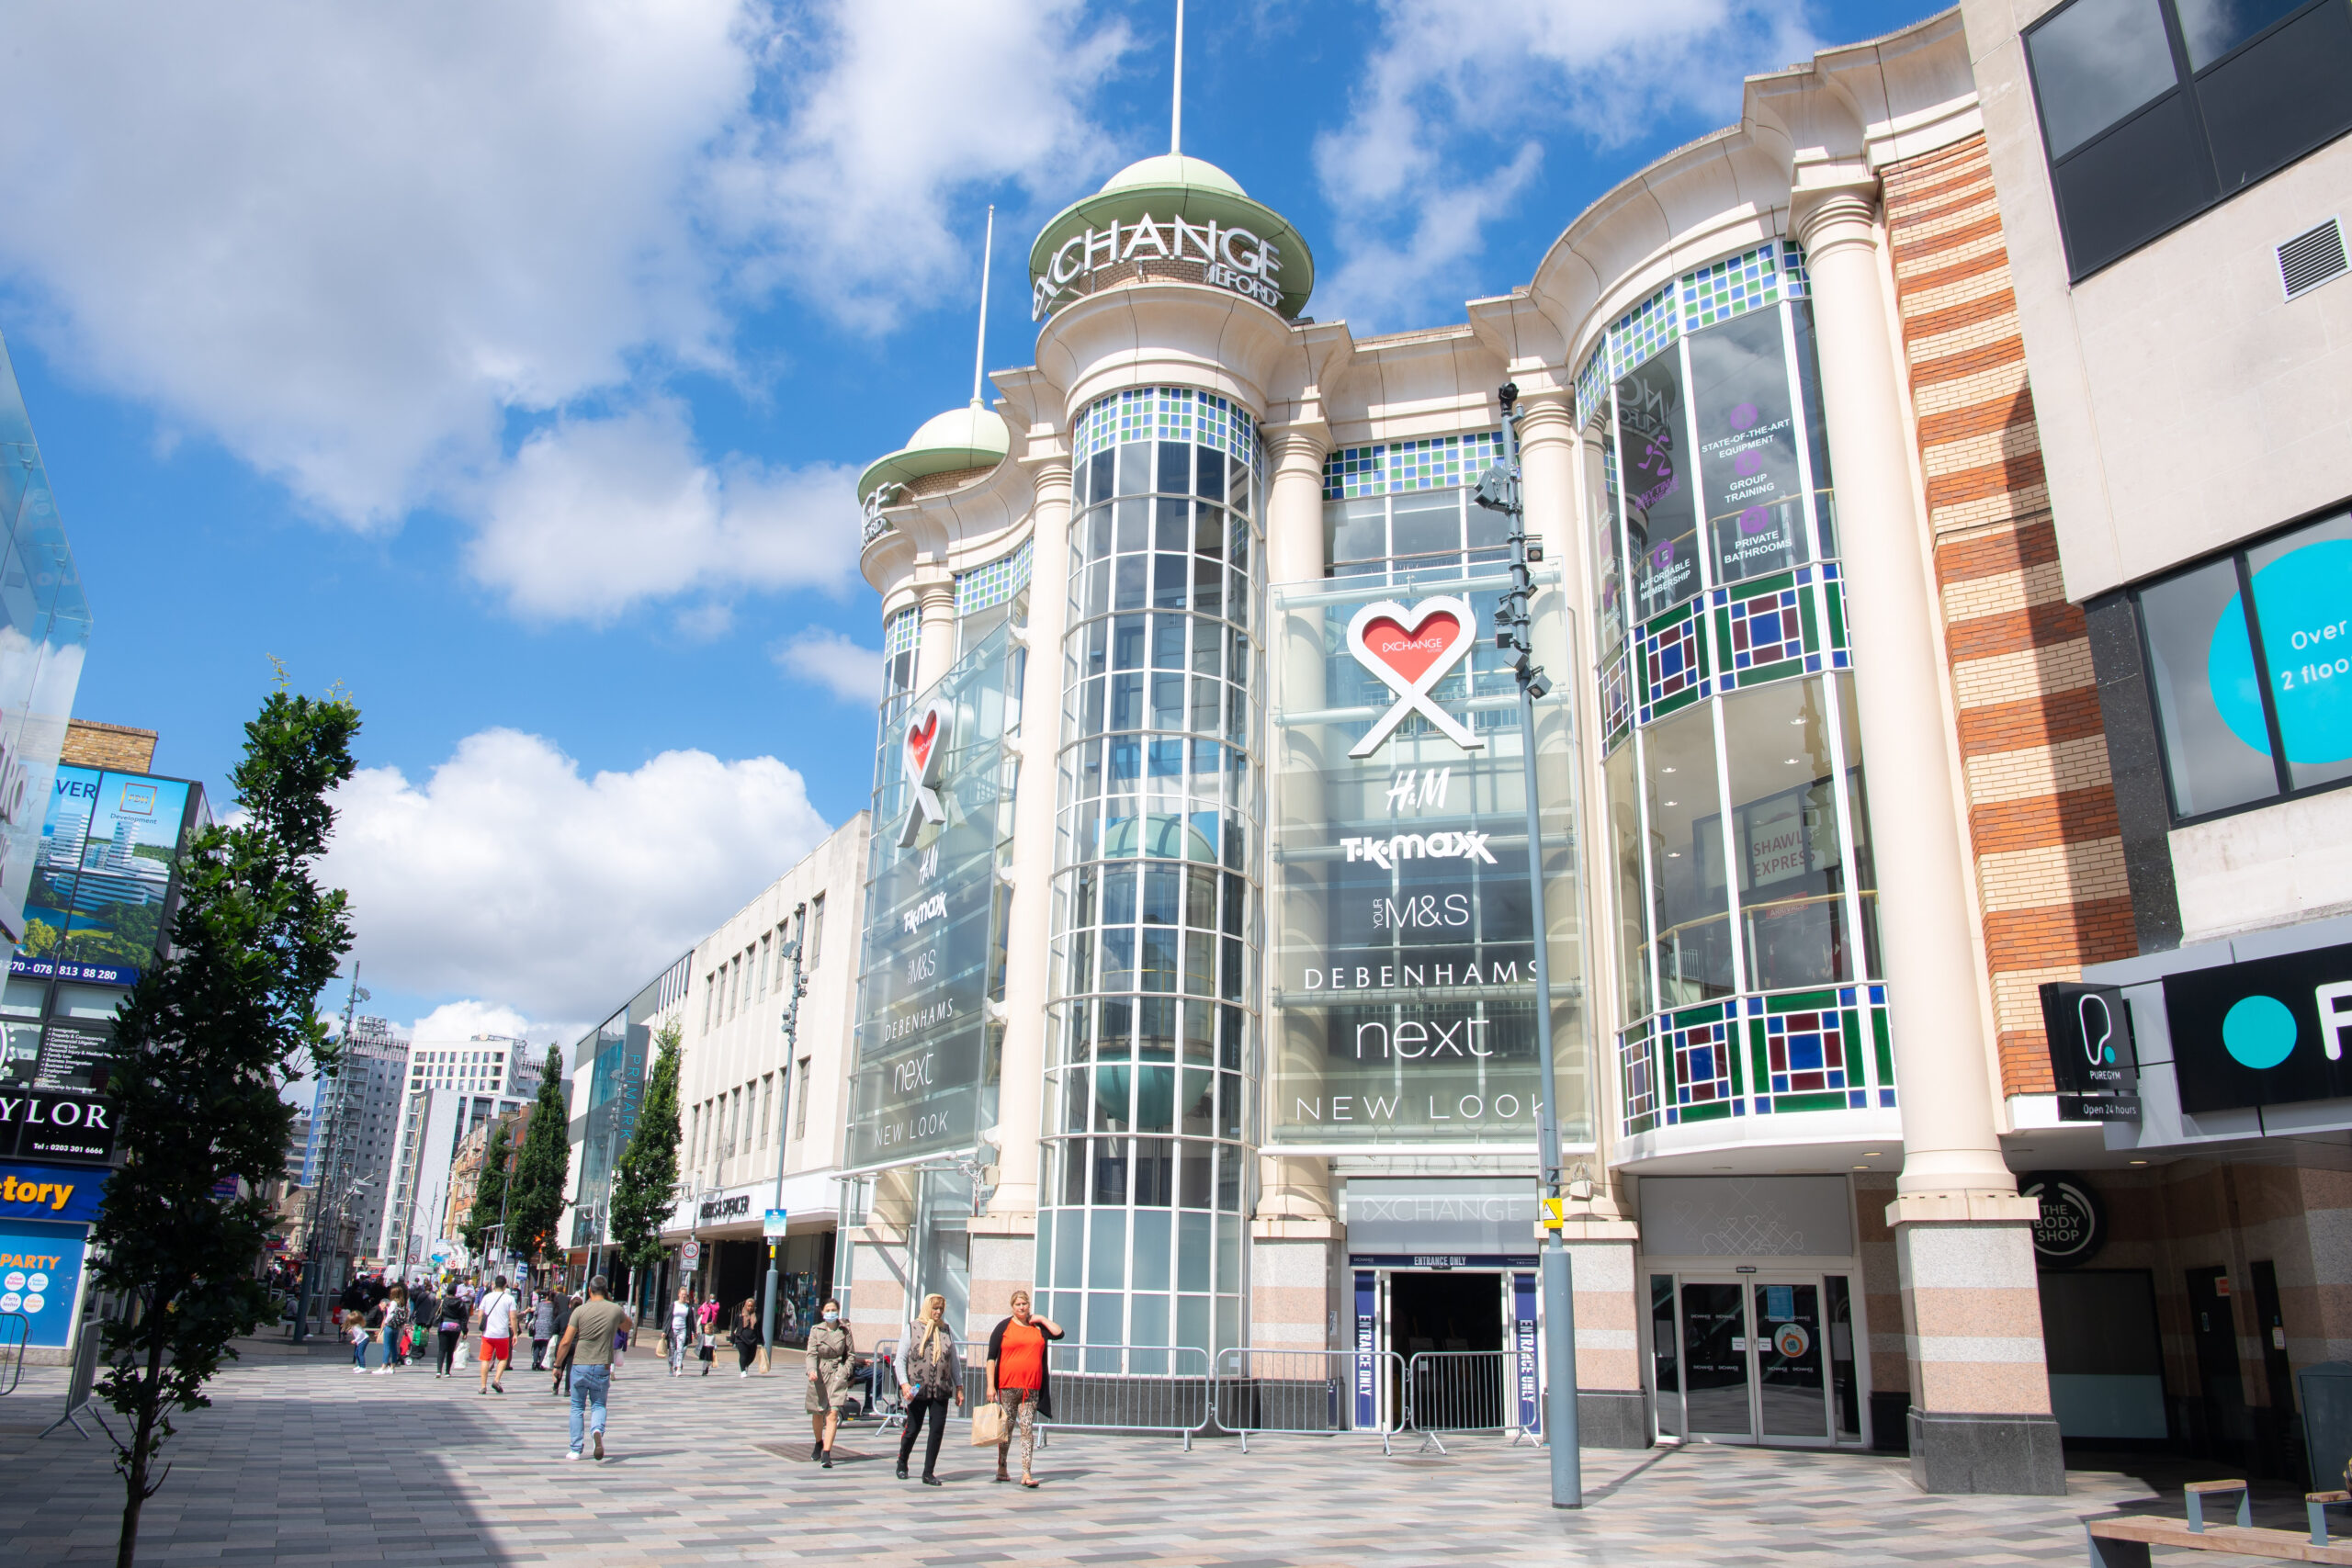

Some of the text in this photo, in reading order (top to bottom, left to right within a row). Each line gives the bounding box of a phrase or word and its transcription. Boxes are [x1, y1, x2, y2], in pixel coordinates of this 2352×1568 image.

[1209, 265, 1278, 307] ILFORD
[1702, 419, 1790, 453] STATE-OF-THE-ART
[1719, 434, 1774, 458] EQUIPMENT
[1724, 482, 1775, 503] TRAINING
[1729, 473, 1768, 491] GROUP
[1724, 538, 1792, 565] BATHROOMS
[1735, 530, 1779, 549] PRIVATE
[1639, 558, 1690, 591] AFFORDABLE
[1640, 570, 1691, 602] MEMBERSHIP
[2291, 620, 2347, 649] Over
[2281, 655, 2352, 691] 2 floo
[1385, 767, 1451, 812] H&M
[110, 813, 158, 825] Development
[1753, 829, 1814, 857] SHAWL
[1373, 897, 1384, 929] YOUR
[1385, 894, 1469, 929] M&S
[33, 964, 52, 974] 078
[59, 965, 78, 976] 813
[83, 968, 96, 978] 88
[97, 970, 117, 980] 280
[910, 949, 935, 984] M&S
[1305, 959, 1538, 990] DEBENHAMS
[884, 998, 954, 1042] DEBENHAMS
[75, 1034, 107, 1043] Conveyancing
[1356, 1016, 1493, 1058] next
[893, 1052, 934, 1094] next
[2090, 1070, 2121, 1080] PUREGYM
[619, 1054, 642, 1140] PRIMARK
[1296, 1096, 1398, 1121] NEW
[2084, 1104, 2137, 1118] Open 24 hours
[0, 1097, 110, 1129] YLOR
[875, 1110, 949, 1146] NEW LOOK
[0, 1176, 74, 1211] tory
[1362, 1197, 1521, 1223] EXCHANGE
[2033, 1216, 2079, 1229] BODY
[2041, 1204, 2068, 1215] THE
[2038, 1230, 2079, 1242] SHOP
[0, 1254, 62, 1270] PARTY
[1414, 1256, 1466, 1266] ENTRANCE ONLY
[1360, 1371, 1373, 1396] ONLY
